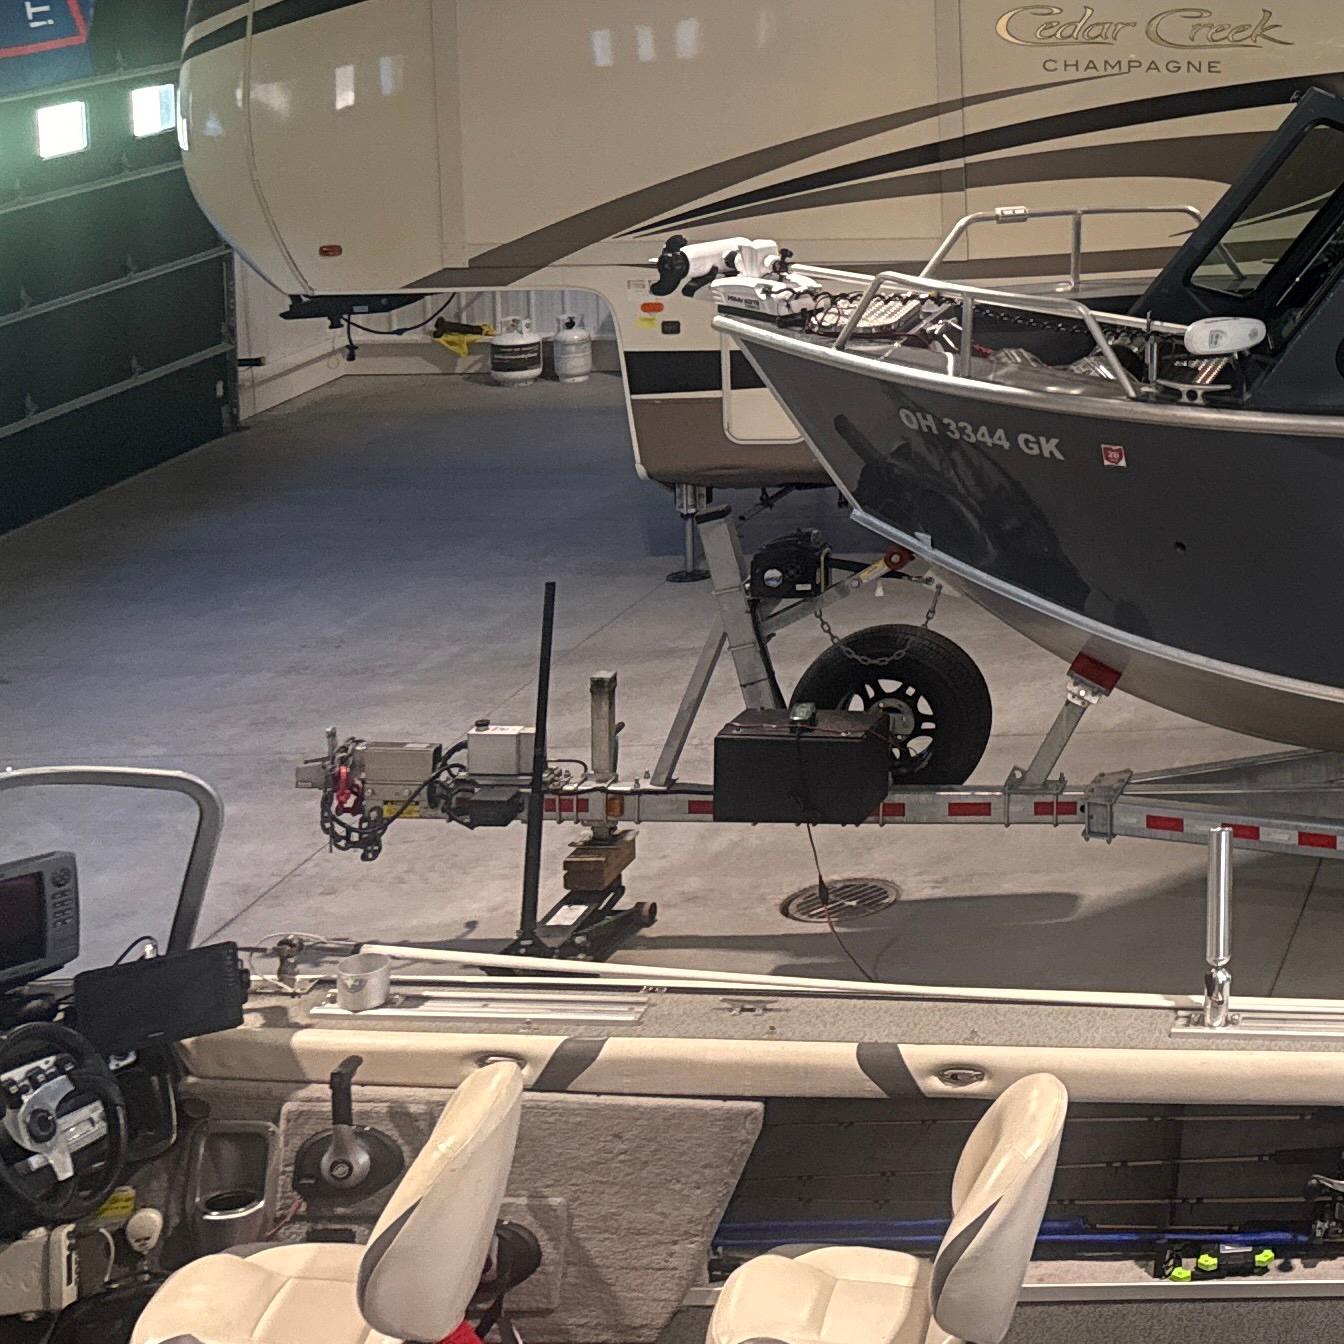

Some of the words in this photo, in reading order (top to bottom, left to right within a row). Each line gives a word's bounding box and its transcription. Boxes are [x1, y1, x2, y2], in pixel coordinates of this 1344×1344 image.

[995, 4, 1137, 47] Cedar
[1145, 8, 1295, 49] Creek
[1042, 59, 1222, 74] CHAMPAGNE
[900, 408, 938, 435] OH
[942, 417, 1010, 450] 3344
[1017, 433, 1065, 460] GK
